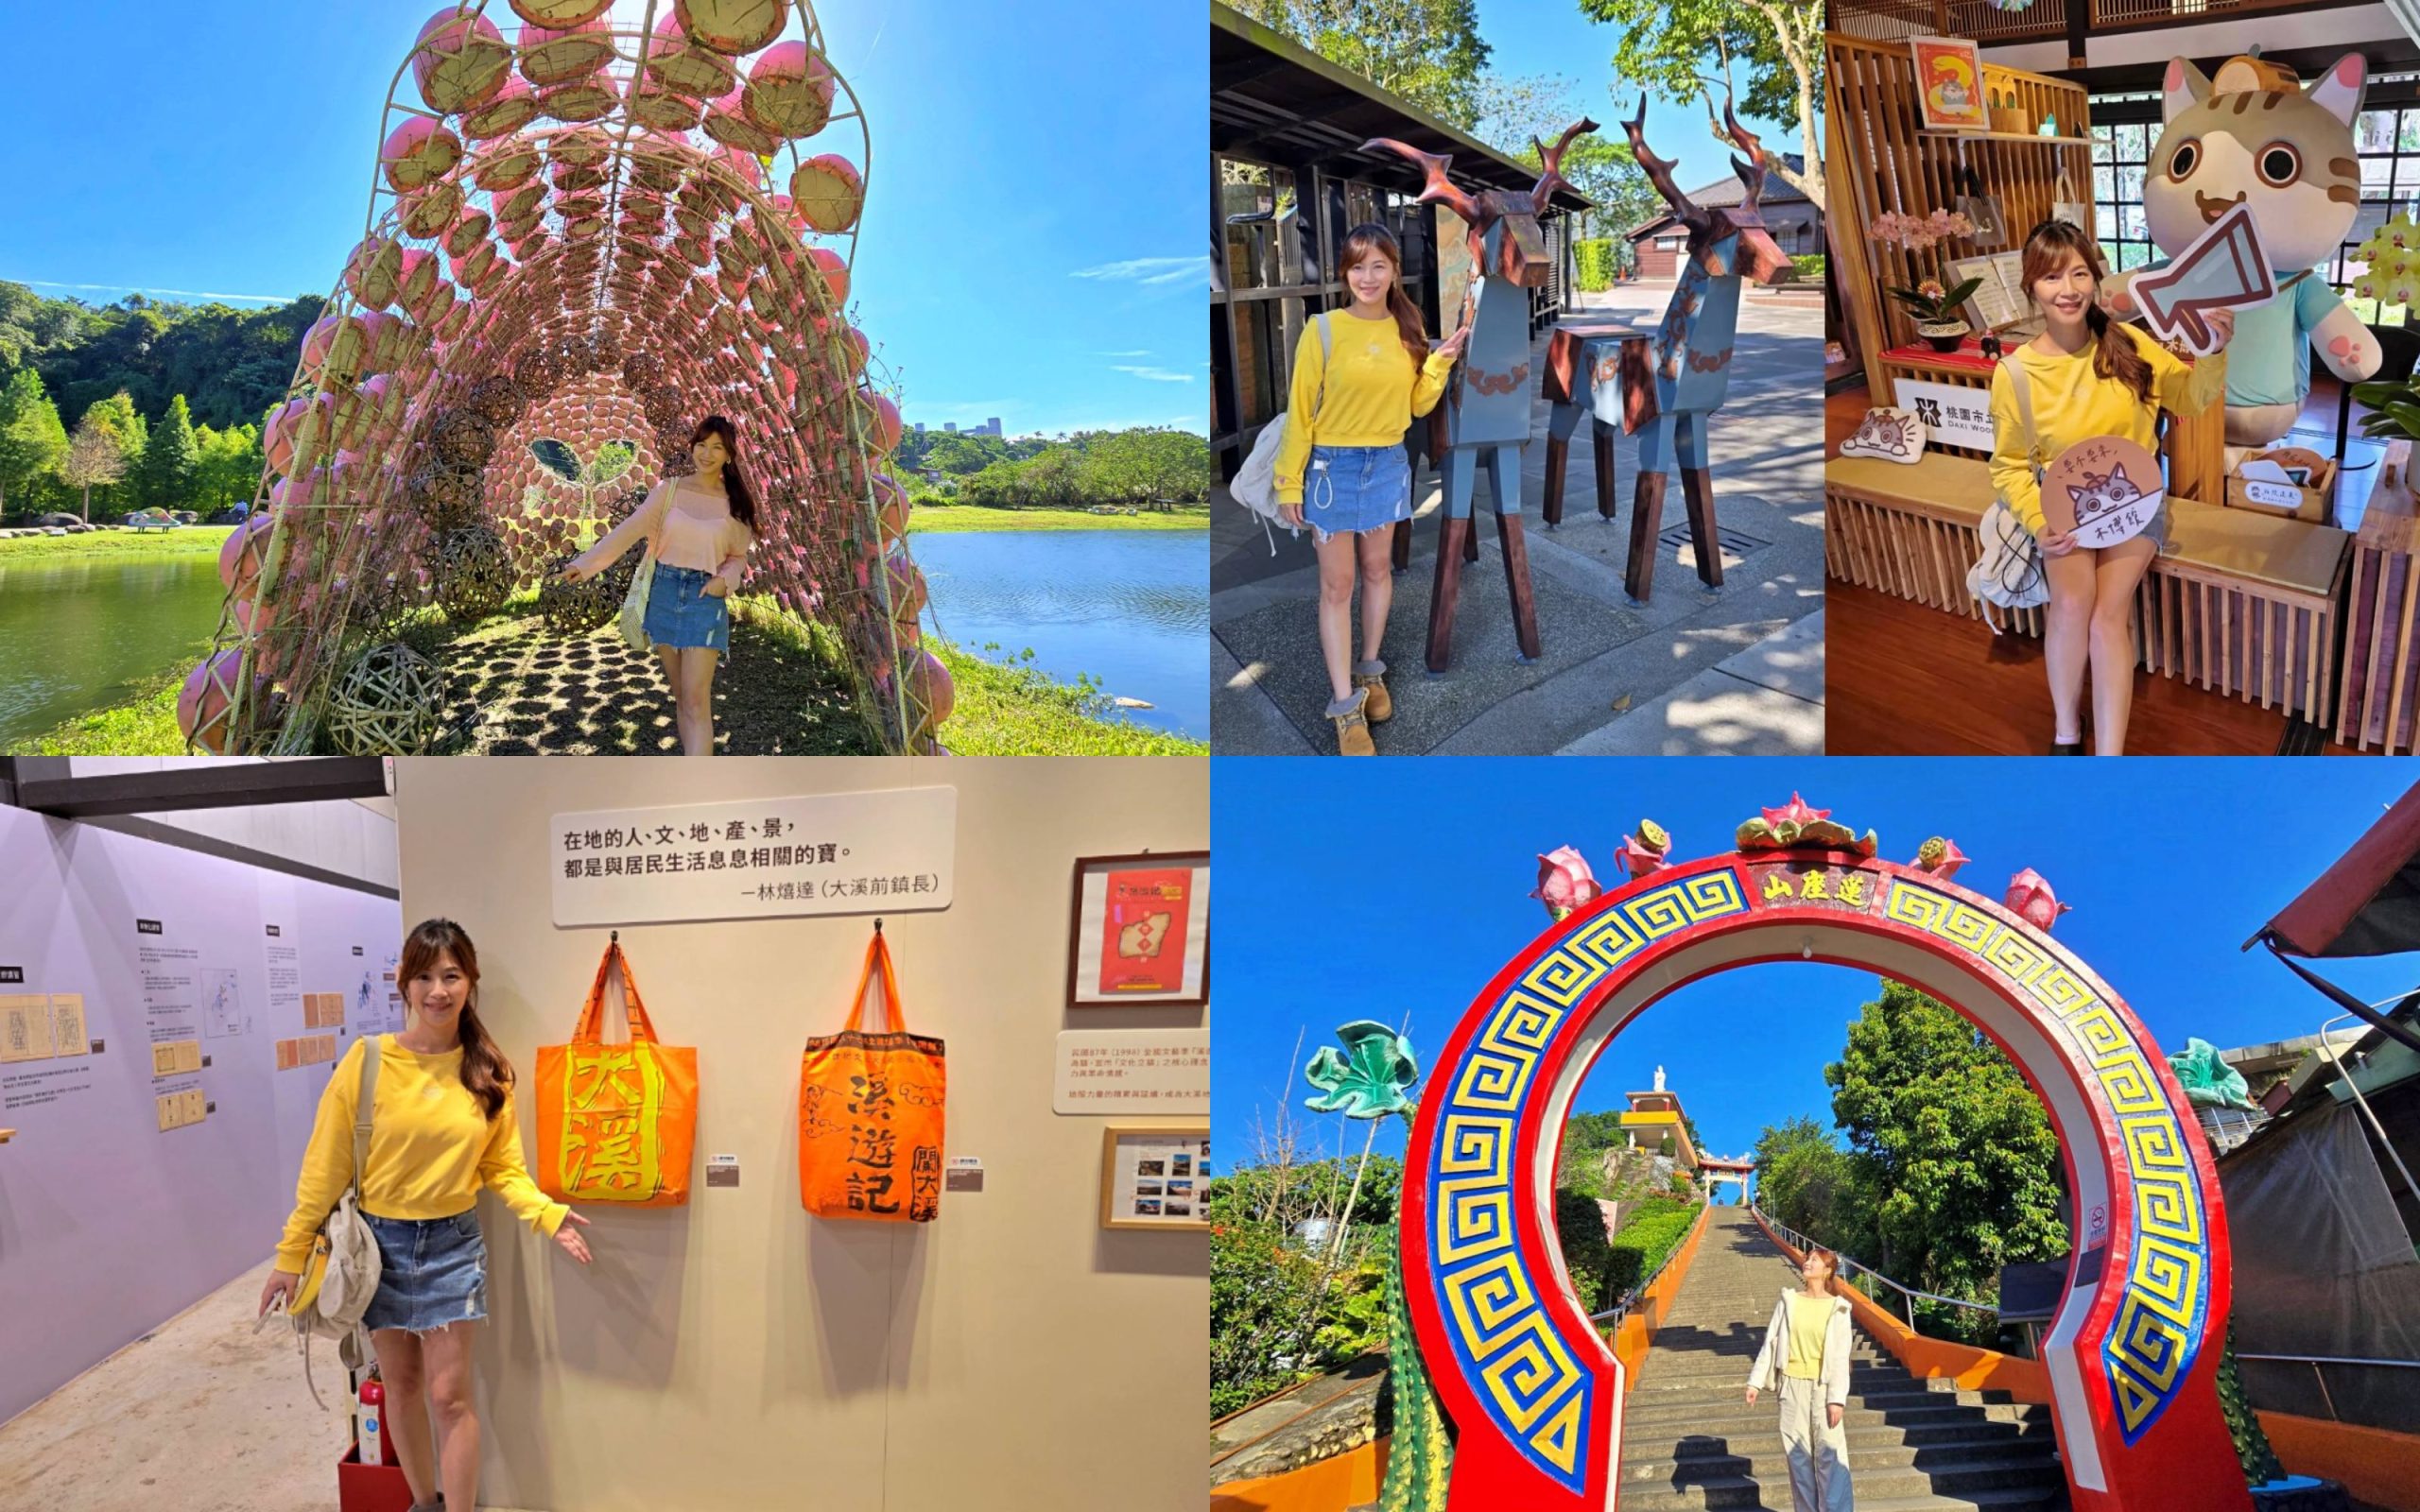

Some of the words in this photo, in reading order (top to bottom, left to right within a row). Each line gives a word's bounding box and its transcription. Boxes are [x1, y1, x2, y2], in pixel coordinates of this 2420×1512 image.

[1947, 420, 1968, 430] DAXI
[1971, 423, 1995, 434] WOO
[846, 1070, 901, 1214] 溪遊記
